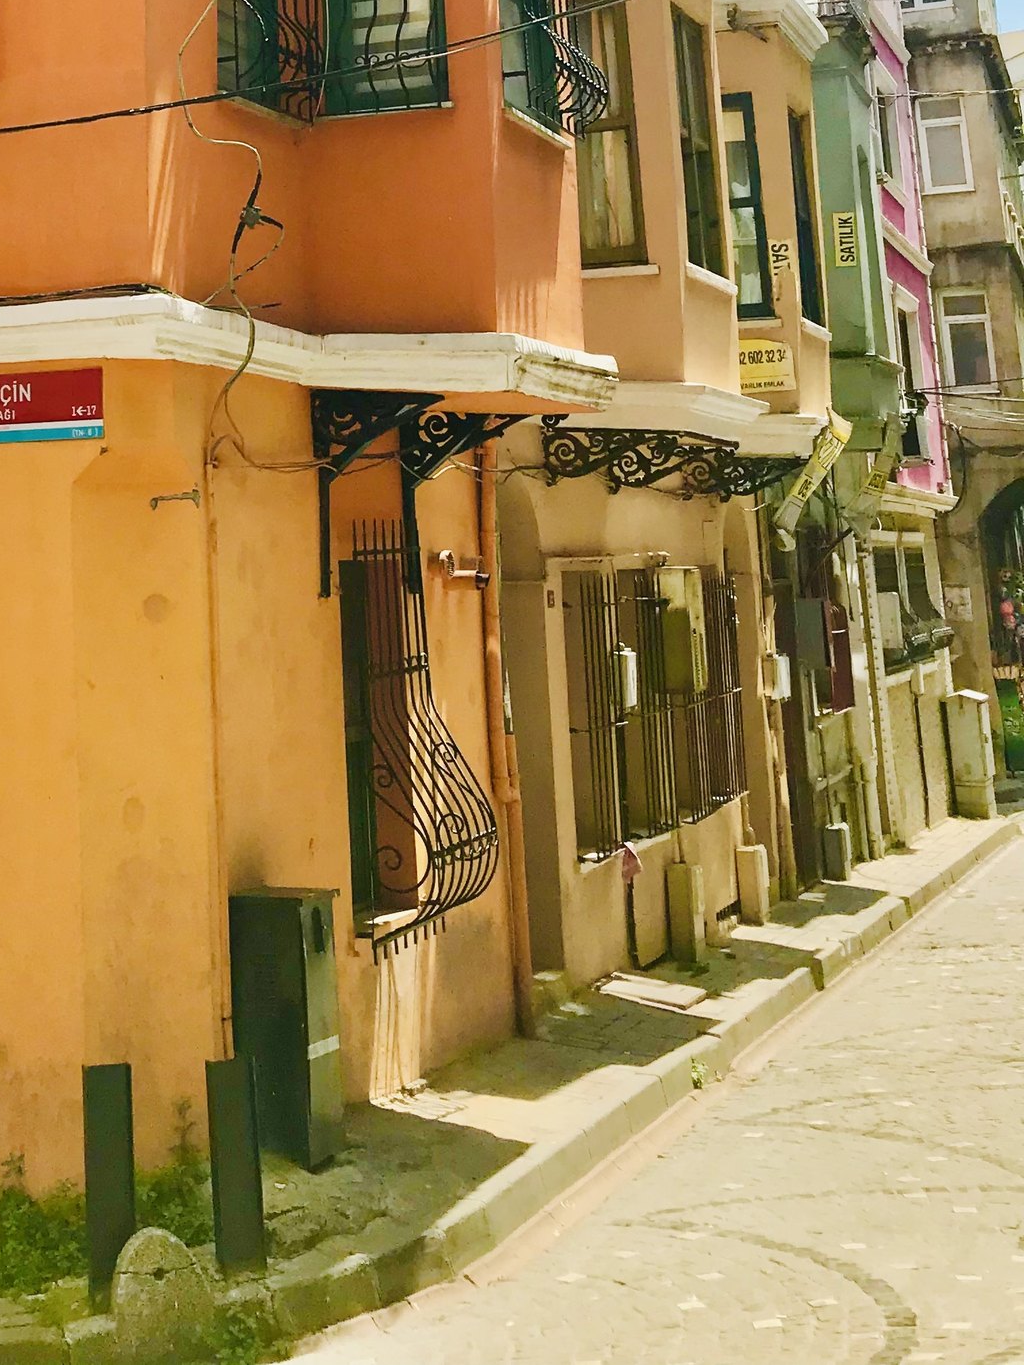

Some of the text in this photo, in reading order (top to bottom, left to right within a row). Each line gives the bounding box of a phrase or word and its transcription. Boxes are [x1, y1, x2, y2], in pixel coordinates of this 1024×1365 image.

[838, 216, 855, 263] SATILIK
[748, 350, 764, 364] 602
[765, 349, 776, 363] 32
